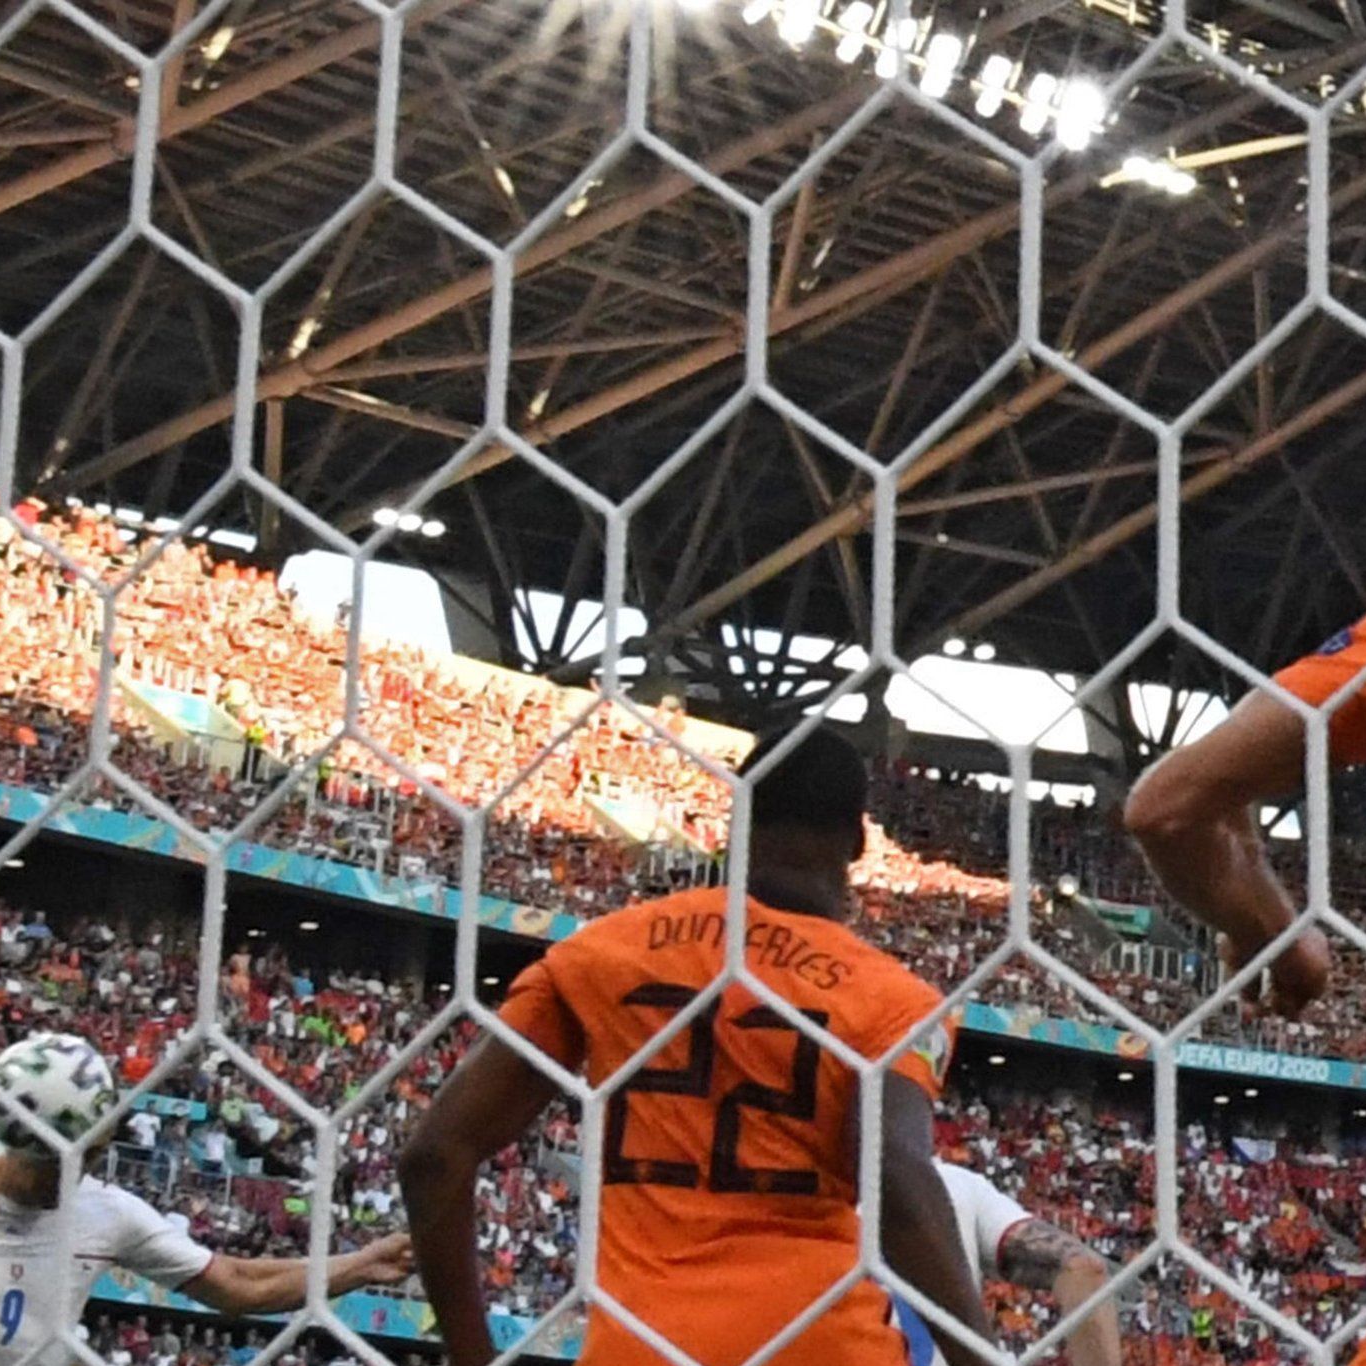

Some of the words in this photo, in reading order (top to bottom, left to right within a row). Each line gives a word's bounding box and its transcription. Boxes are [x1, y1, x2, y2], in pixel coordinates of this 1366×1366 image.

[600, 982, 829, 1195] 22
[1224, 1050, 1279, 1075] EURO
[1281, 1055, 1330, 1082] 2020
[0, 1289, 25, 1346] 9
